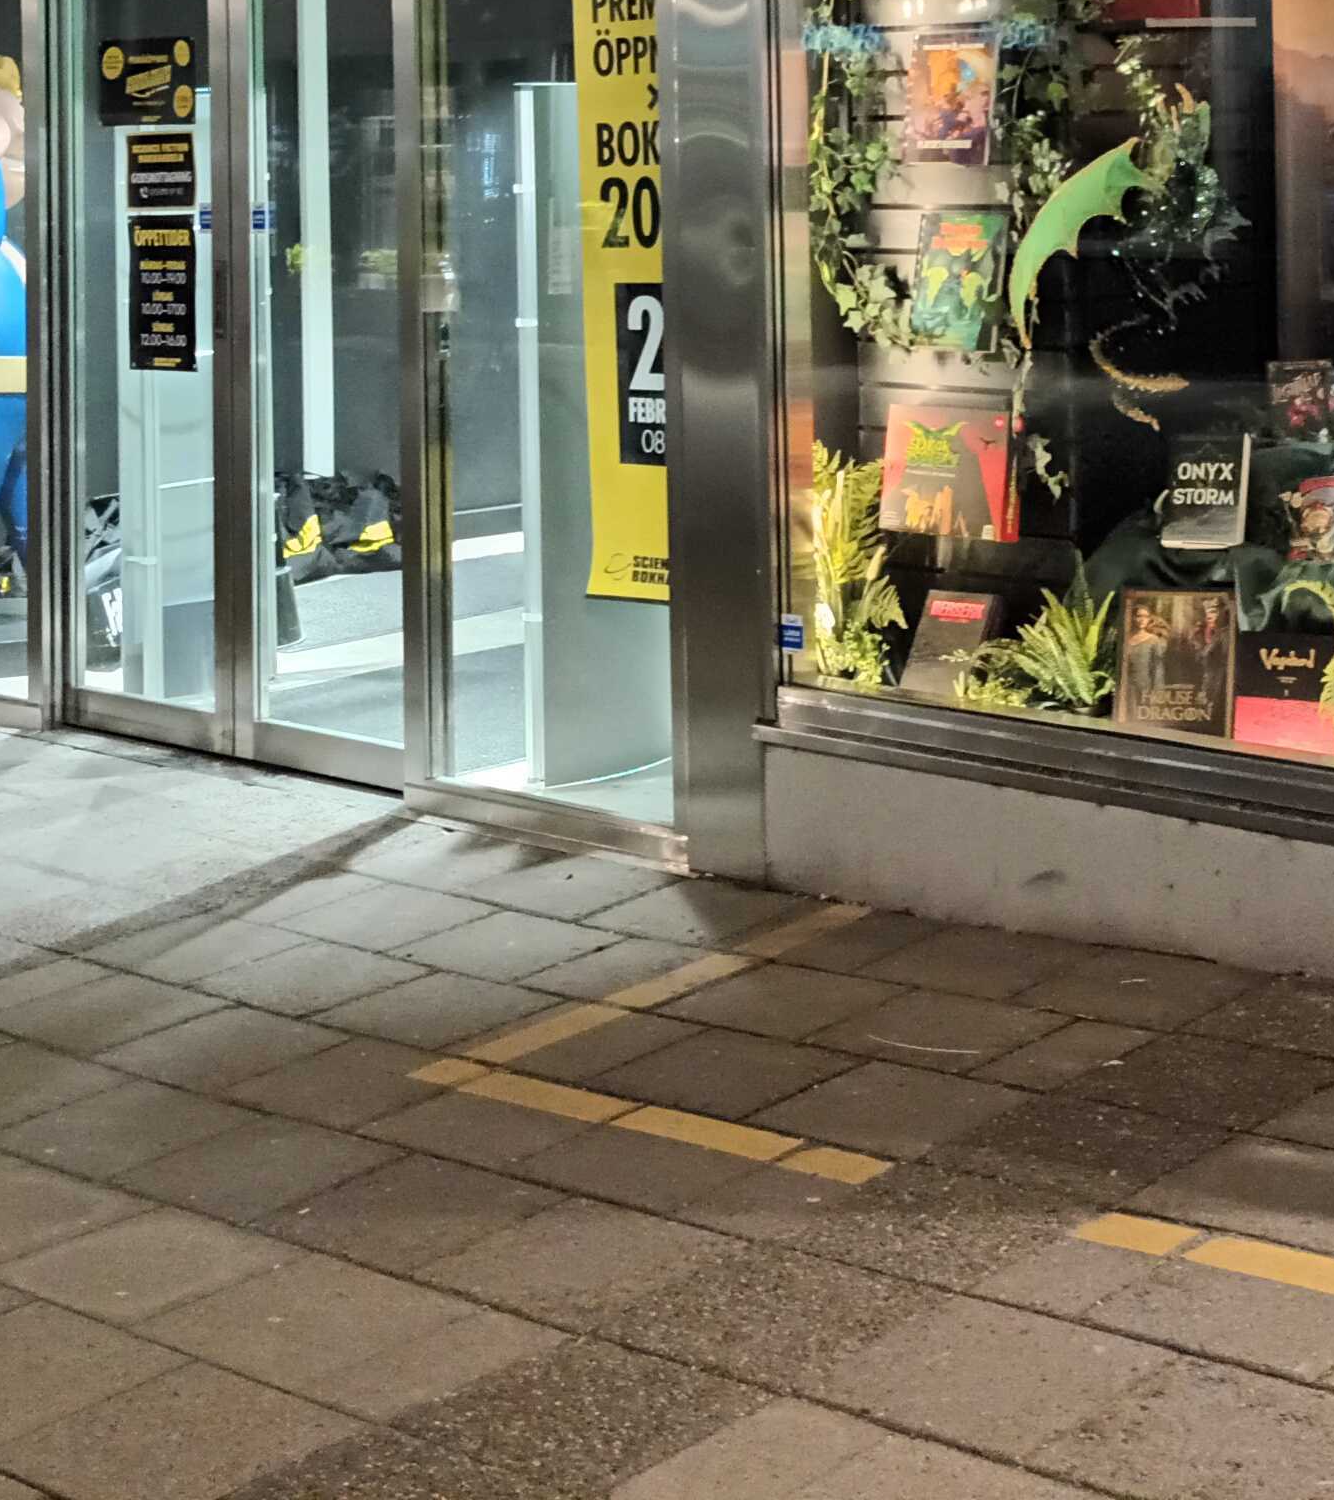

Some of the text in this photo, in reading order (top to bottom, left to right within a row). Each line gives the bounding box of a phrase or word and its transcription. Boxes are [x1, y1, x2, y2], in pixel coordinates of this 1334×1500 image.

[599, 175, 661, 249] 20
[627, 294, 665, 391] 2
[628, 396, 667, 425] FEBR
[641, 429, 667, 455] 08
[1177, 462, 1235, 482] ONYX
[1172, 487, 1236, 507] STORM
[1141, 689, 1196, 706] HOUSE
[1137, 702, 1214, 722] DRAGON
